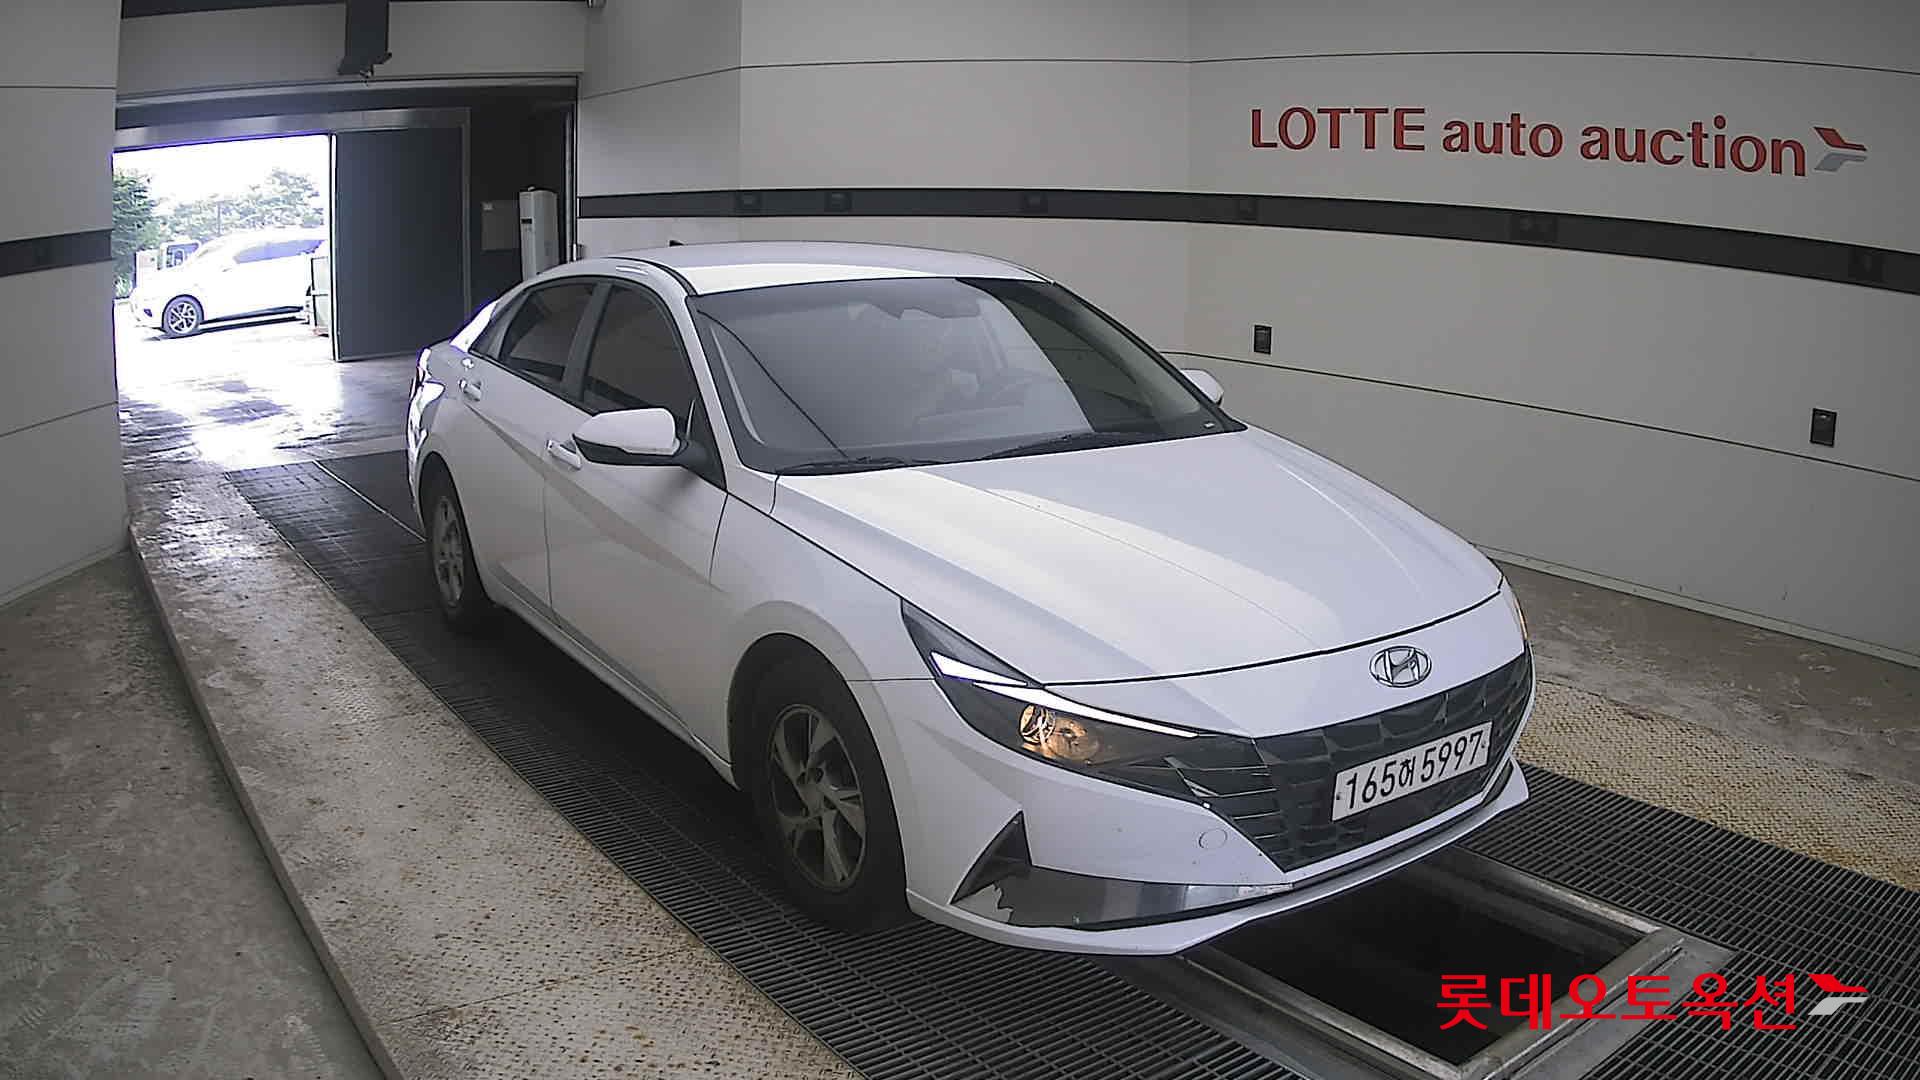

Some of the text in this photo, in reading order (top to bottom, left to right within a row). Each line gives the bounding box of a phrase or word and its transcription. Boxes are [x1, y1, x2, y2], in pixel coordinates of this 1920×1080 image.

[1251, 107, 1806, 177] LOTTE auto auction
[1420, 730, 1484, 783] 5997
